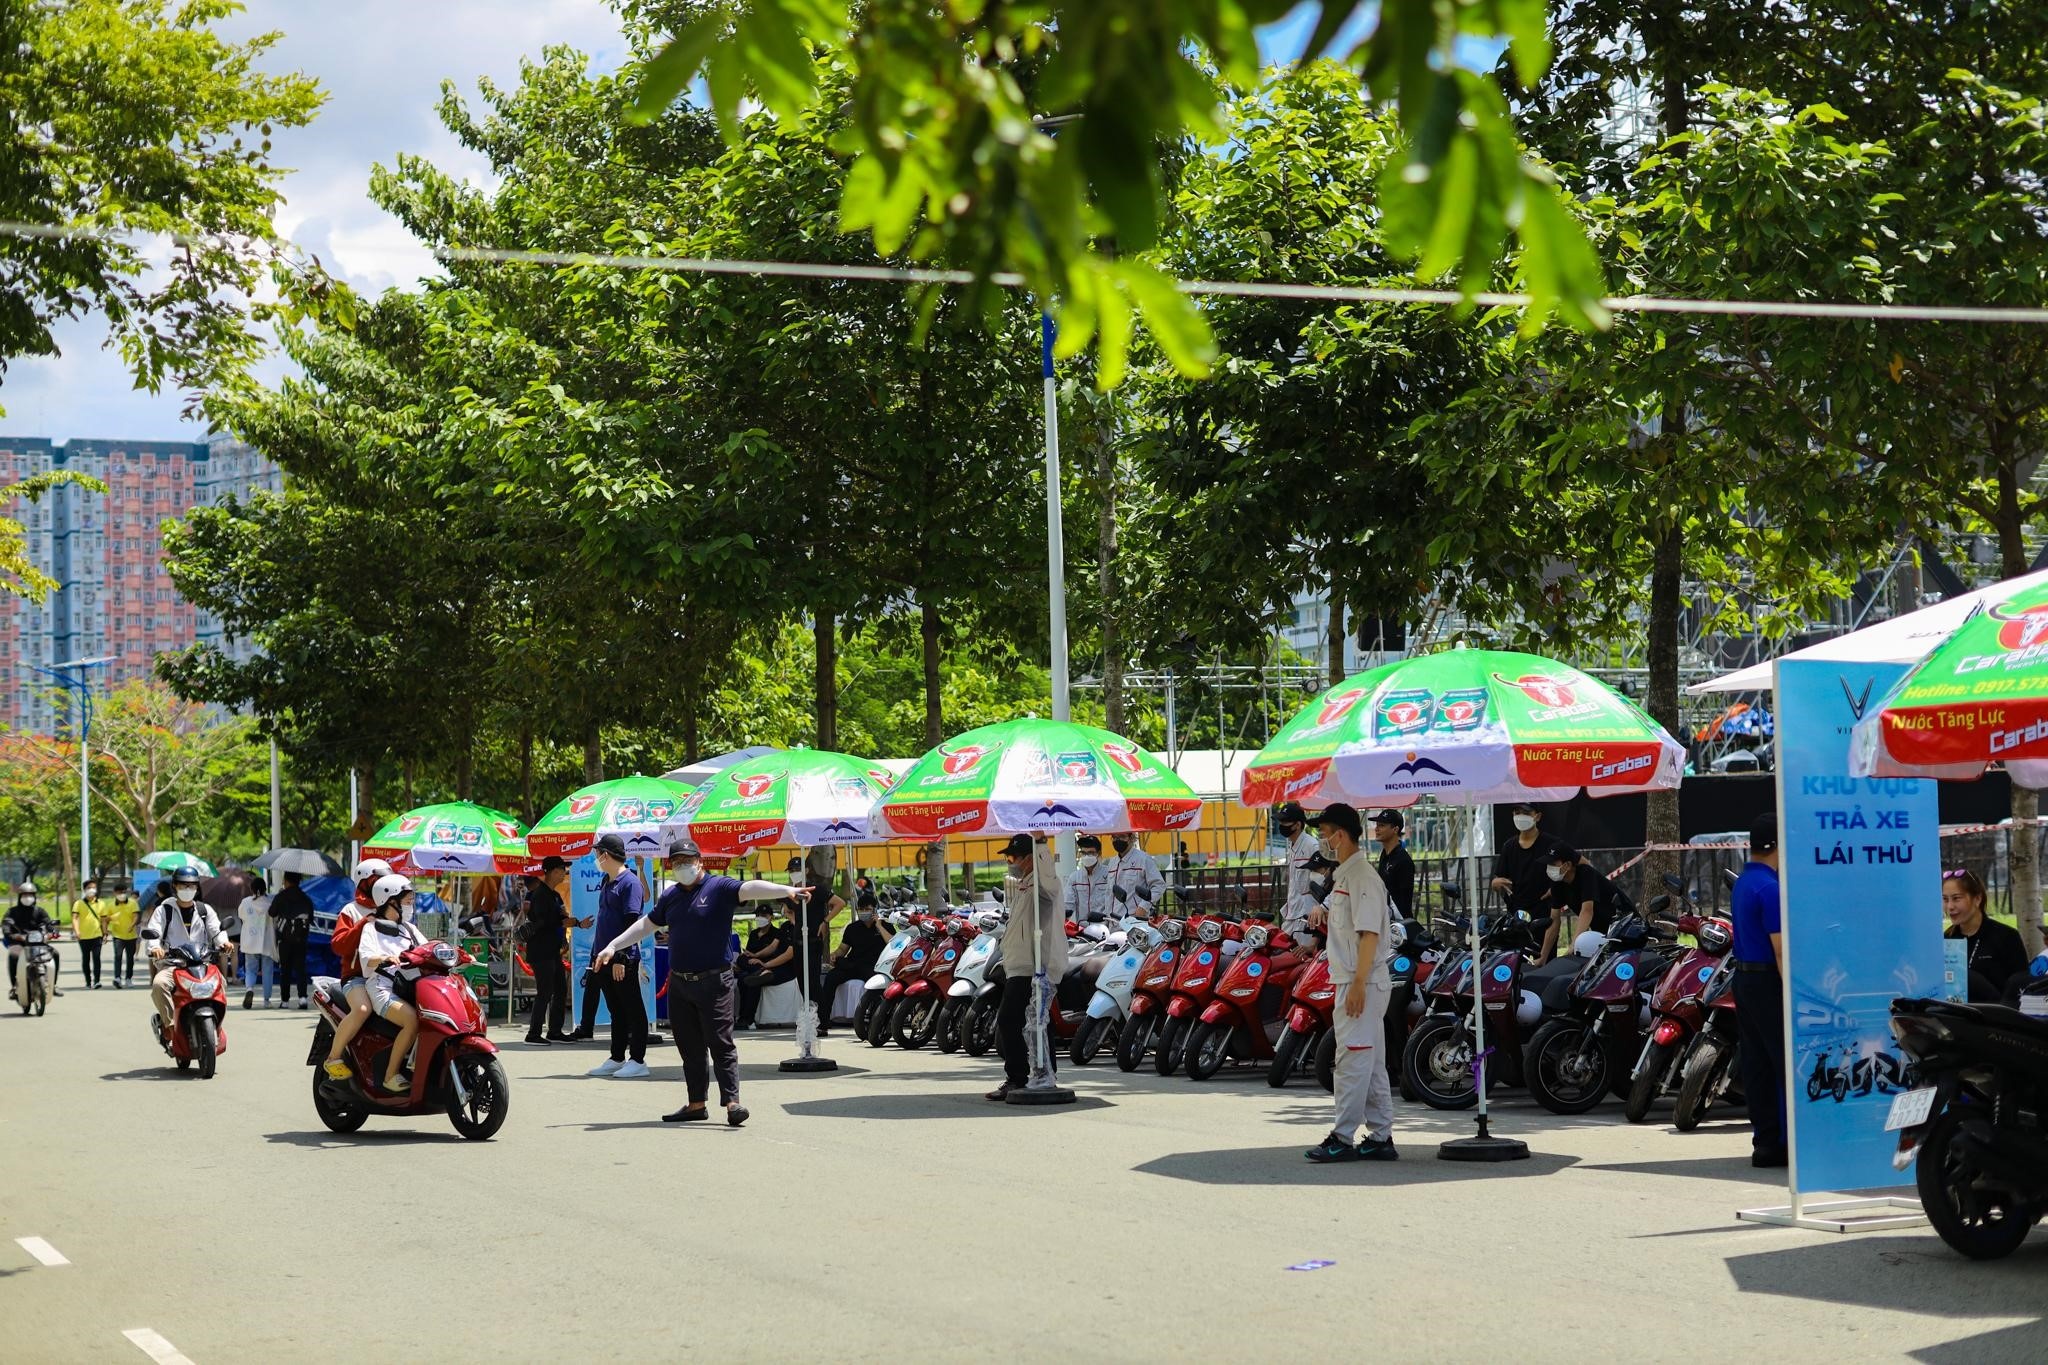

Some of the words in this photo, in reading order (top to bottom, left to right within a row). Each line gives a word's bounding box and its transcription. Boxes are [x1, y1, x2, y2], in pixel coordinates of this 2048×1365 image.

[1955, 643, 2048, 675] Caraba
[1904, 683, 1970, 699] Hotline:
[1892, 713, 1934, 730] Nước
[1937, 711, 1974, 731] Tăng
[1978, 708, 2006, 727] Lực
[1990, 718, 2048, 754] Carab
[1523, 748, 1552, 761] Nước
[1555, 748, 1582, 763] Tăng
[1585, 748, 1605, 761] Lực
[1591, 755, 1652, 780] Carabao
[888, 806, 908, 816] Nước
[909, 806, 929, 816] Tăng
[937, 810, 979, 829] Carabao
[1815, 805, 1868, 830] TRẢ
[1876, 810, 1909, 829] XE
[694, 825, 712, 834] Nước
[714, 824, 732, 834] Tăng
[739, 826, 778, 844] Carabao
[1815, 841, 1853, 865] LÁI
[1862, 840, 1914, 864] THỬ
